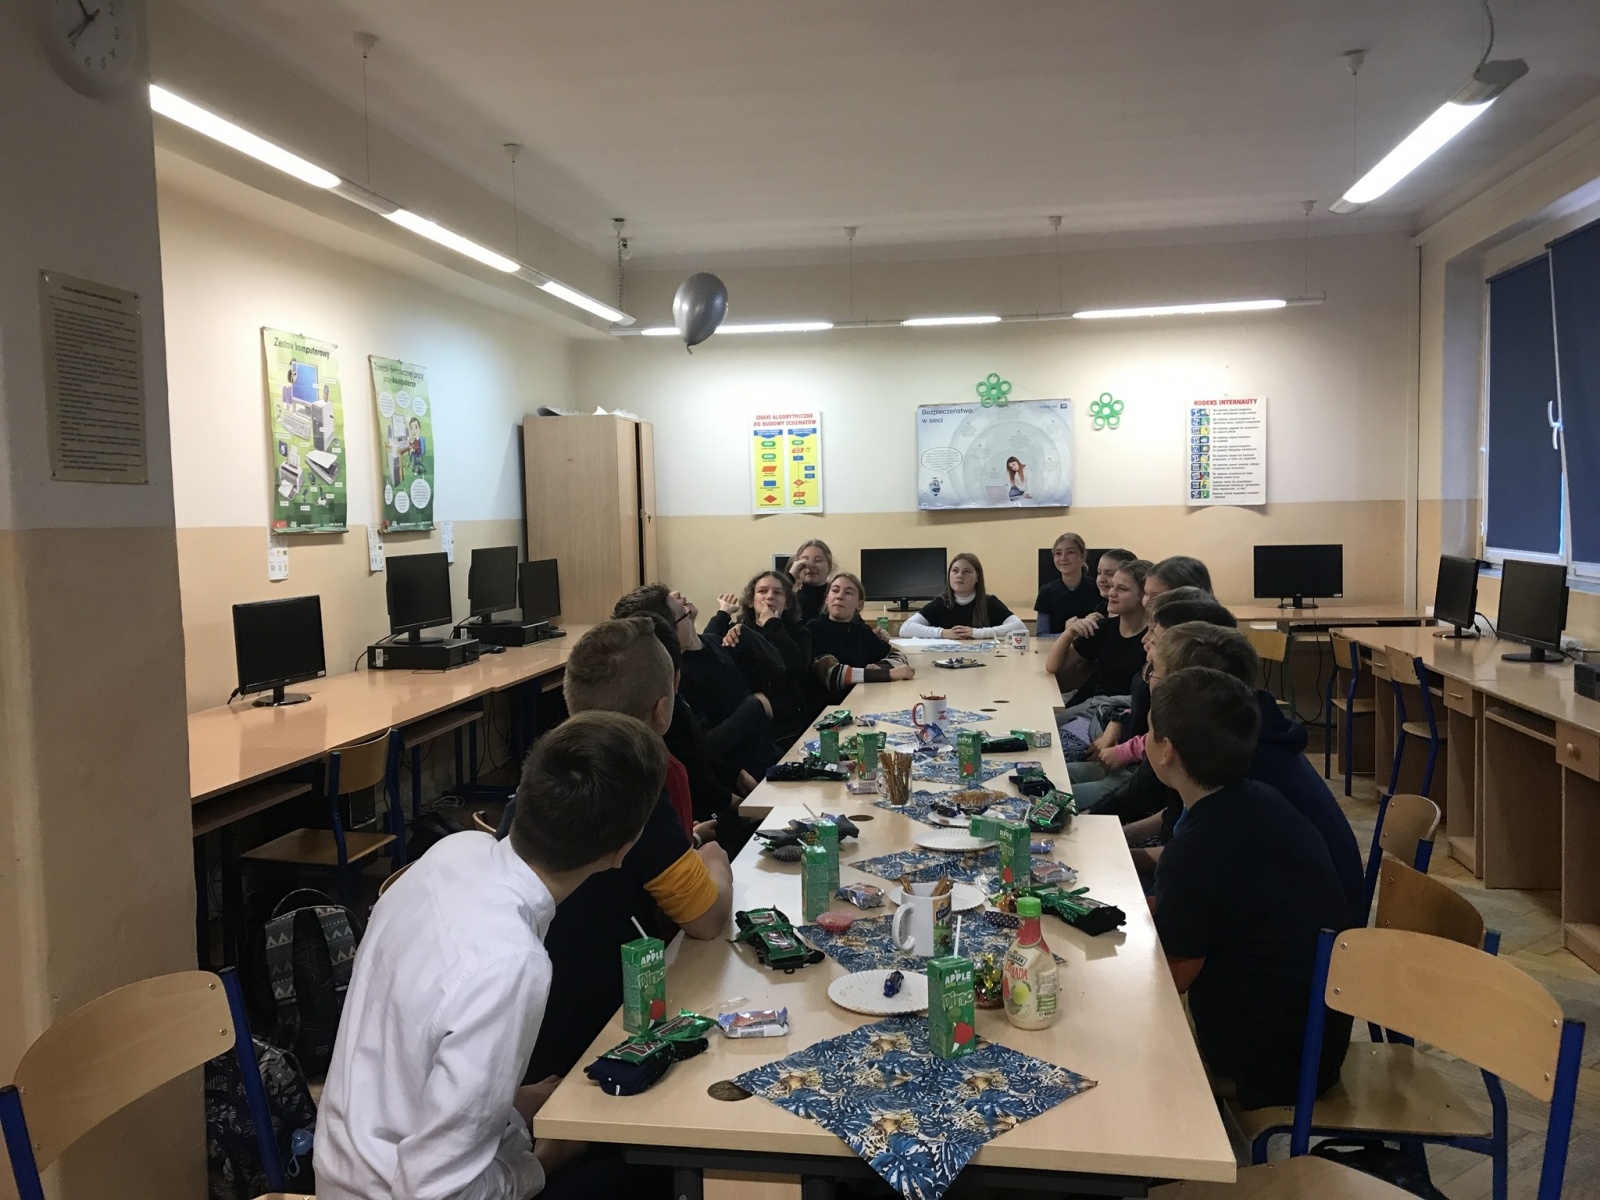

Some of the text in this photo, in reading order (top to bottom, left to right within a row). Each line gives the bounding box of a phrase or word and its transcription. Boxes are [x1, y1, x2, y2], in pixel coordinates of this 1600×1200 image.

[294, 342, 330, 360] komputerowy
[921, 408, 973, 416] Bezpieczeństwo
[785, 418, 817, 426] SCHEMATÓW
[641, 949, 664, 966] APPLE
[944, 970, 973, 985] APPLE
